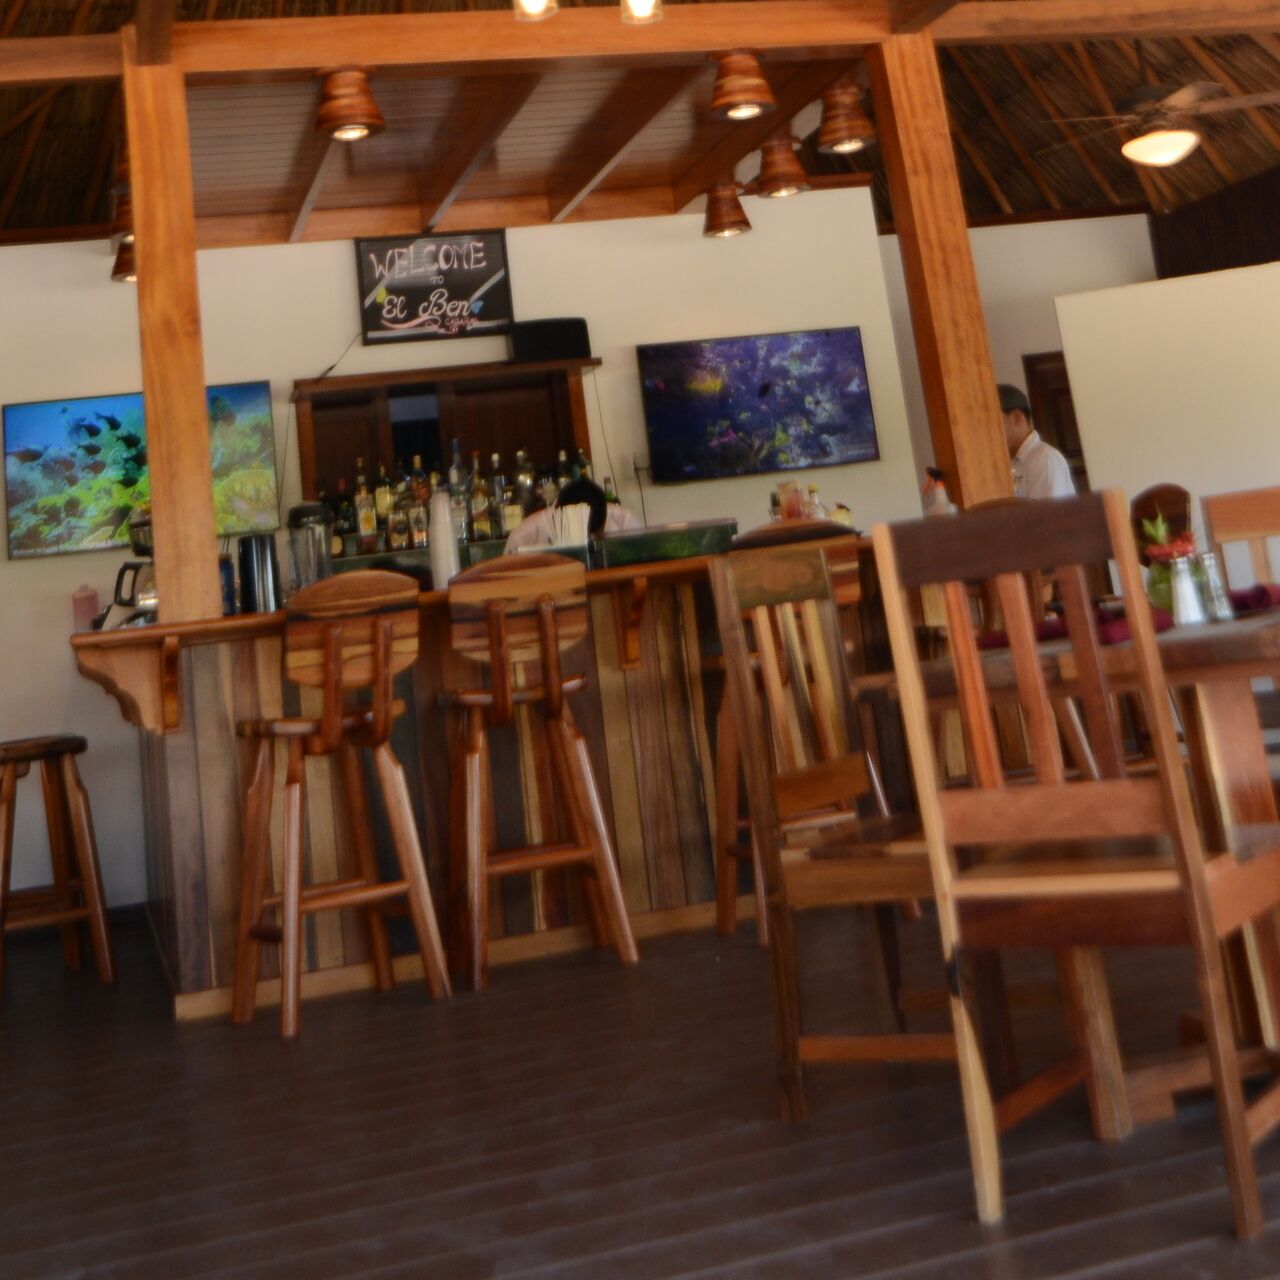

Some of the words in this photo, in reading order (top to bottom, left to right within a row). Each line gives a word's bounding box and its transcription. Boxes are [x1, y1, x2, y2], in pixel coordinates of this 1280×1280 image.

[370, 242, 487, 278] WELCOME
[382, 295, 407, 318] El
[419, 288, 470, 317] Ben
